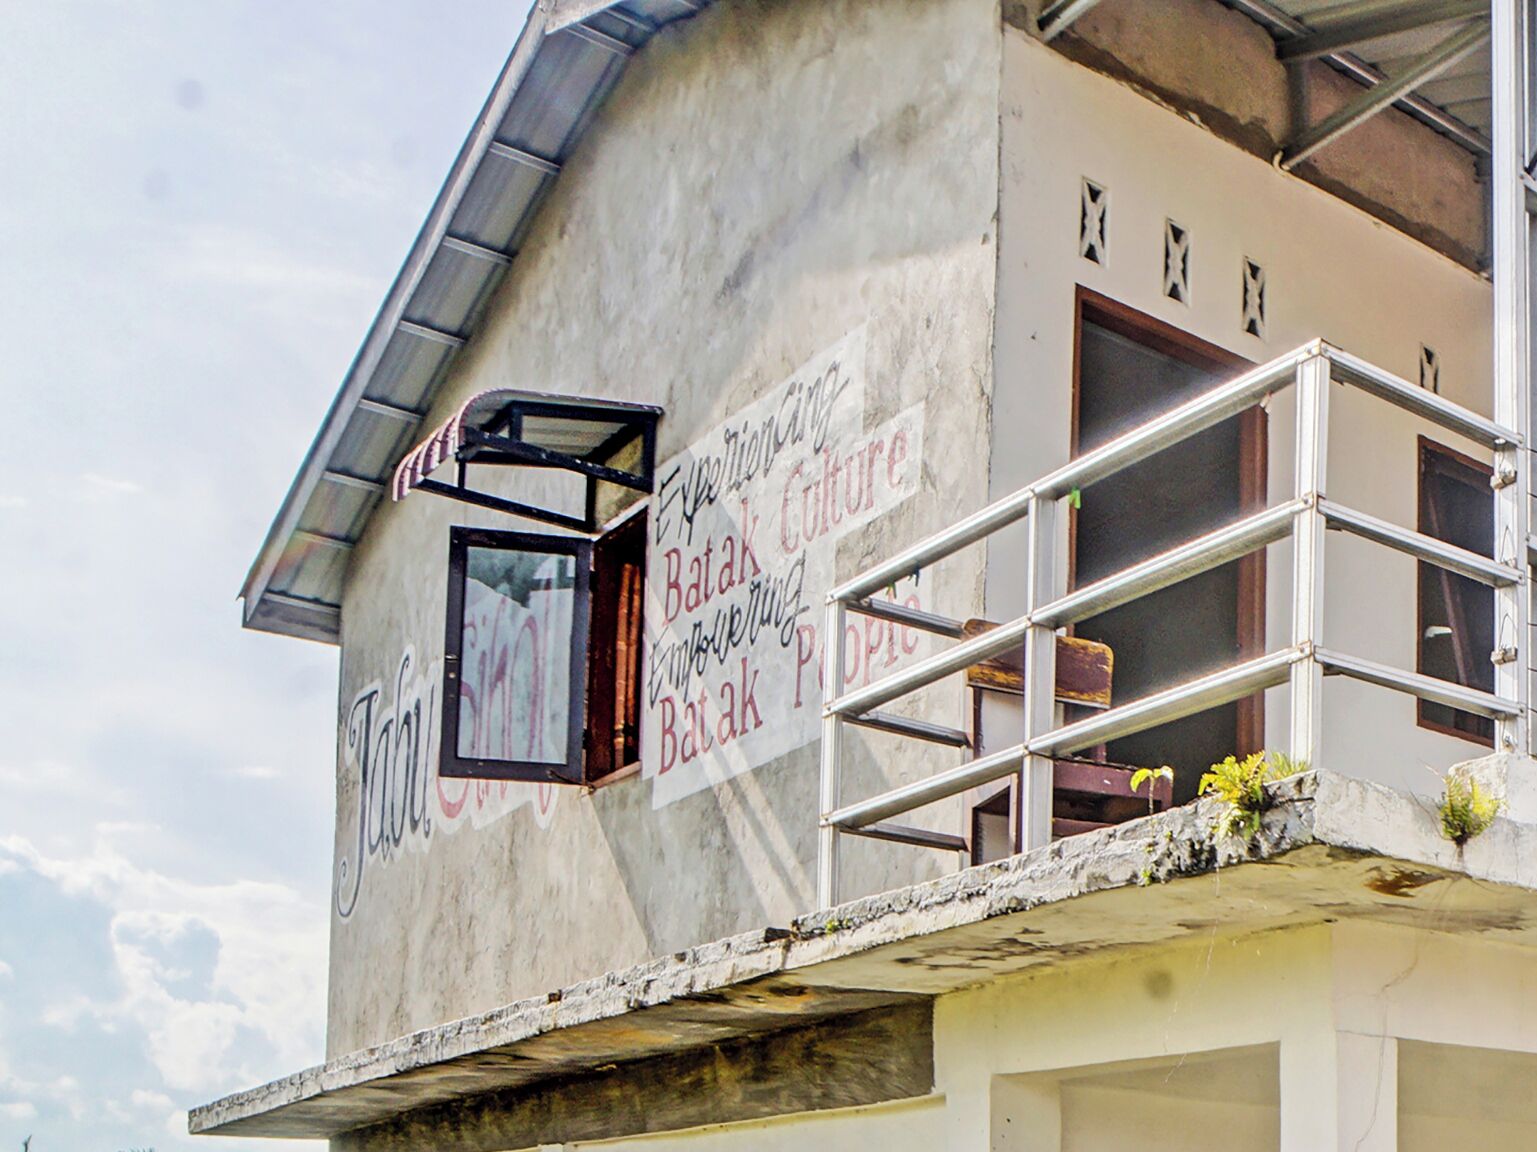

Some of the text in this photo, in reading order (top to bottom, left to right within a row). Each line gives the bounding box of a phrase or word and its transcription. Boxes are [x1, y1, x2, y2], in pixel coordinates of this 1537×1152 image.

[655, 360, 850, 547] Experiencing
[662, 429, 909, 627] Batak Culture
[647, 549, 811, 710] Empowering
[657, 586, 921, 777] Batak Pople
[336, 652, 436, 918] Jabu
